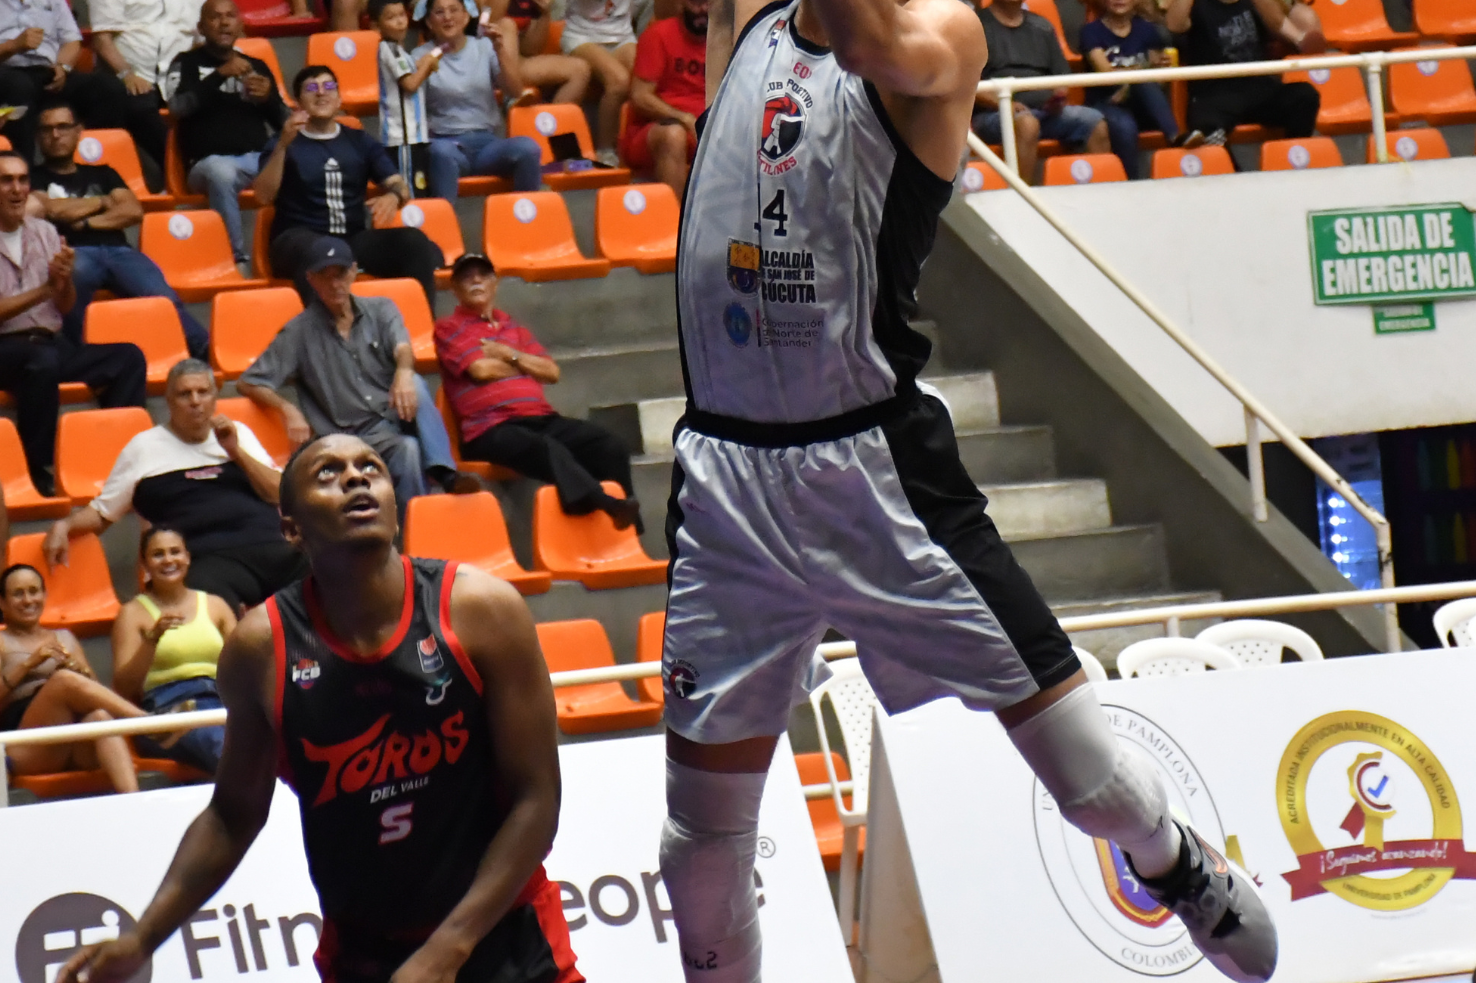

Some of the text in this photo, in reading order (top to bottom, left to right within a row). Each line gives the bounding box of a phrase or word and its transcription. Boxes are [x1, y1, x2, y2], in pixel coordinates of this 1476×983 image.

[675, 58, 706, 76] BO
[1334, 212, 1456, 254] SALIDA DE
[767, 268, 782, 279] SAN
[784, 267, 802, 281] JOSÉ
[804, 270, 815, 281] DE
[1322, 251, 1476, 297] EMERGENCIA
[762, 277, 817, 304] CÚCUTA
[774, 329, 802, 338] Norte
[804, 329, 819, 338] de
[292, 665, 321, 683] FCB
[299, 708, 470, 809] TOROS
[1128, 718, 1199, 799] PAMPLONA
[369, 776, 430, 804] DEL VALLE
[1285, 762, 1301, 825] ACREDITADA
[1390, 732, 1405, 747] EN
[1405, 744, 1427, 766] ALTA
[1425, 764, 1451, 809] CALIDAD
[1121, 938, 1204, 968] COLOMBI
